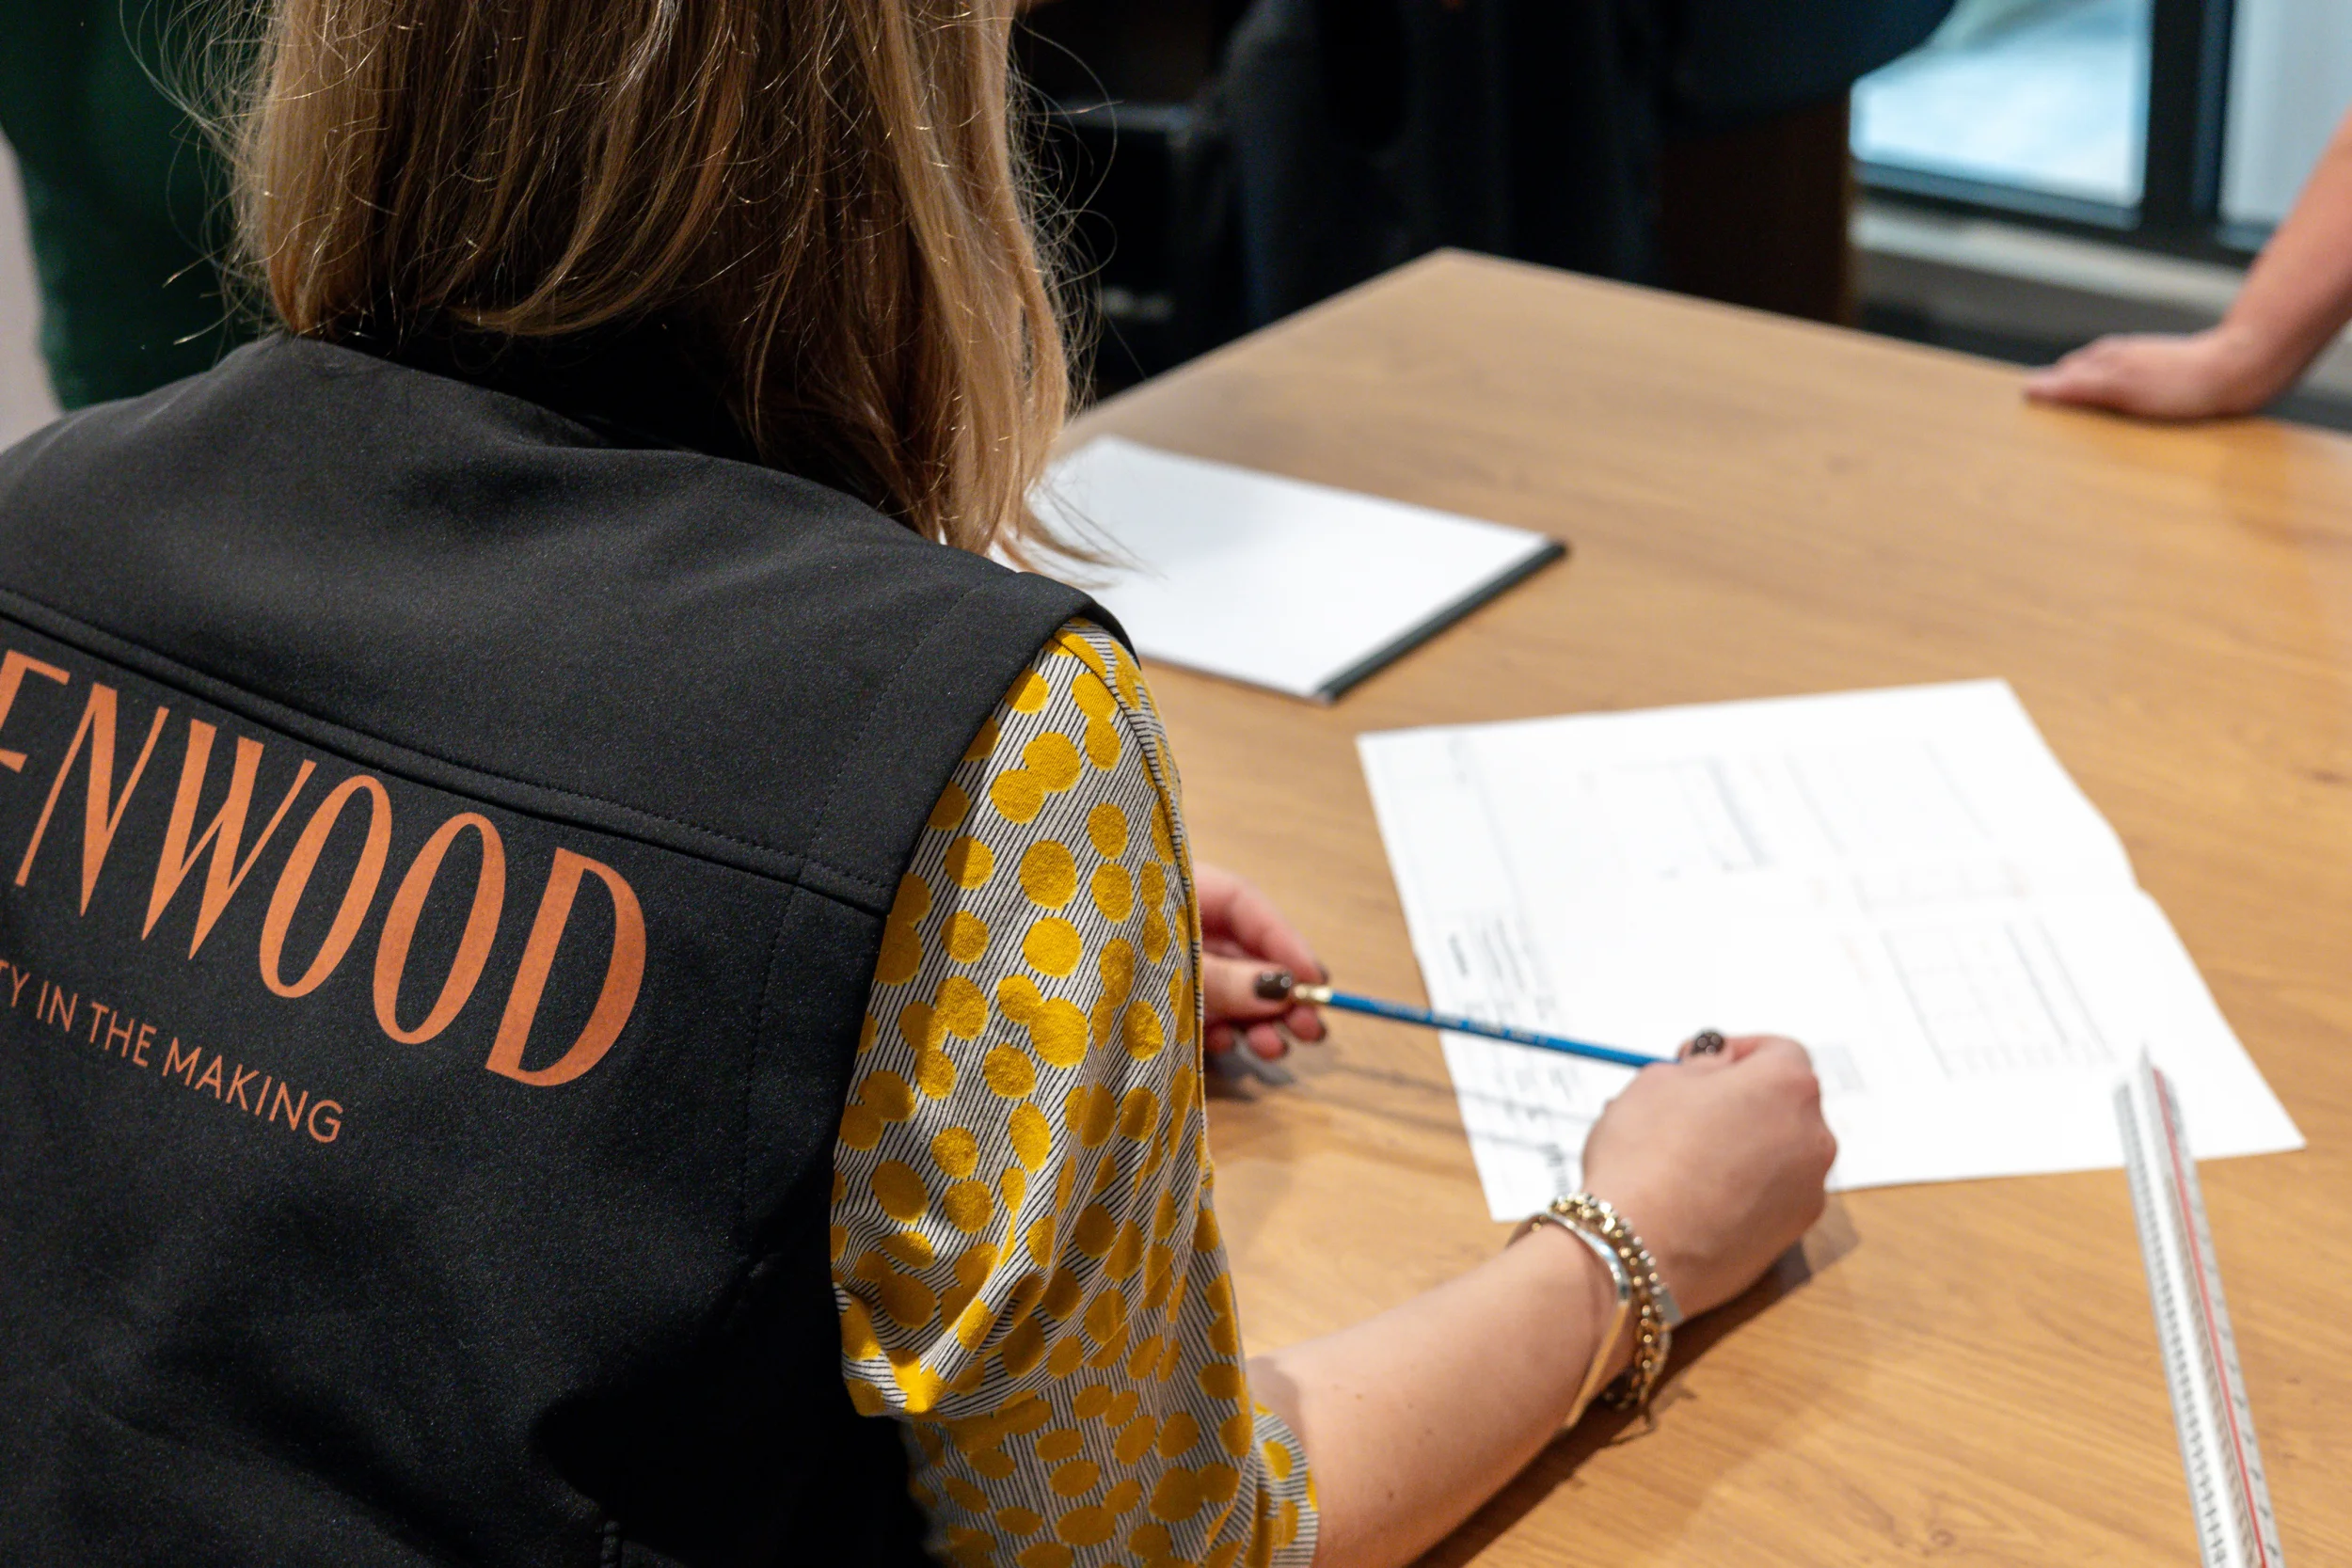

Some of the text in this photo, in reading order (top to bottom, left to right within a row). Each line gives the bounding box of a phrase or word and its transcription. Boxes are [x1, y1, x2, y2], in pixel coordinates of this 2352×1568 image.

[36, 980, 78, 1033] IN
[89, 1001, 158, 1068] THE
[162, 1037, 343, 1144] MAKING
